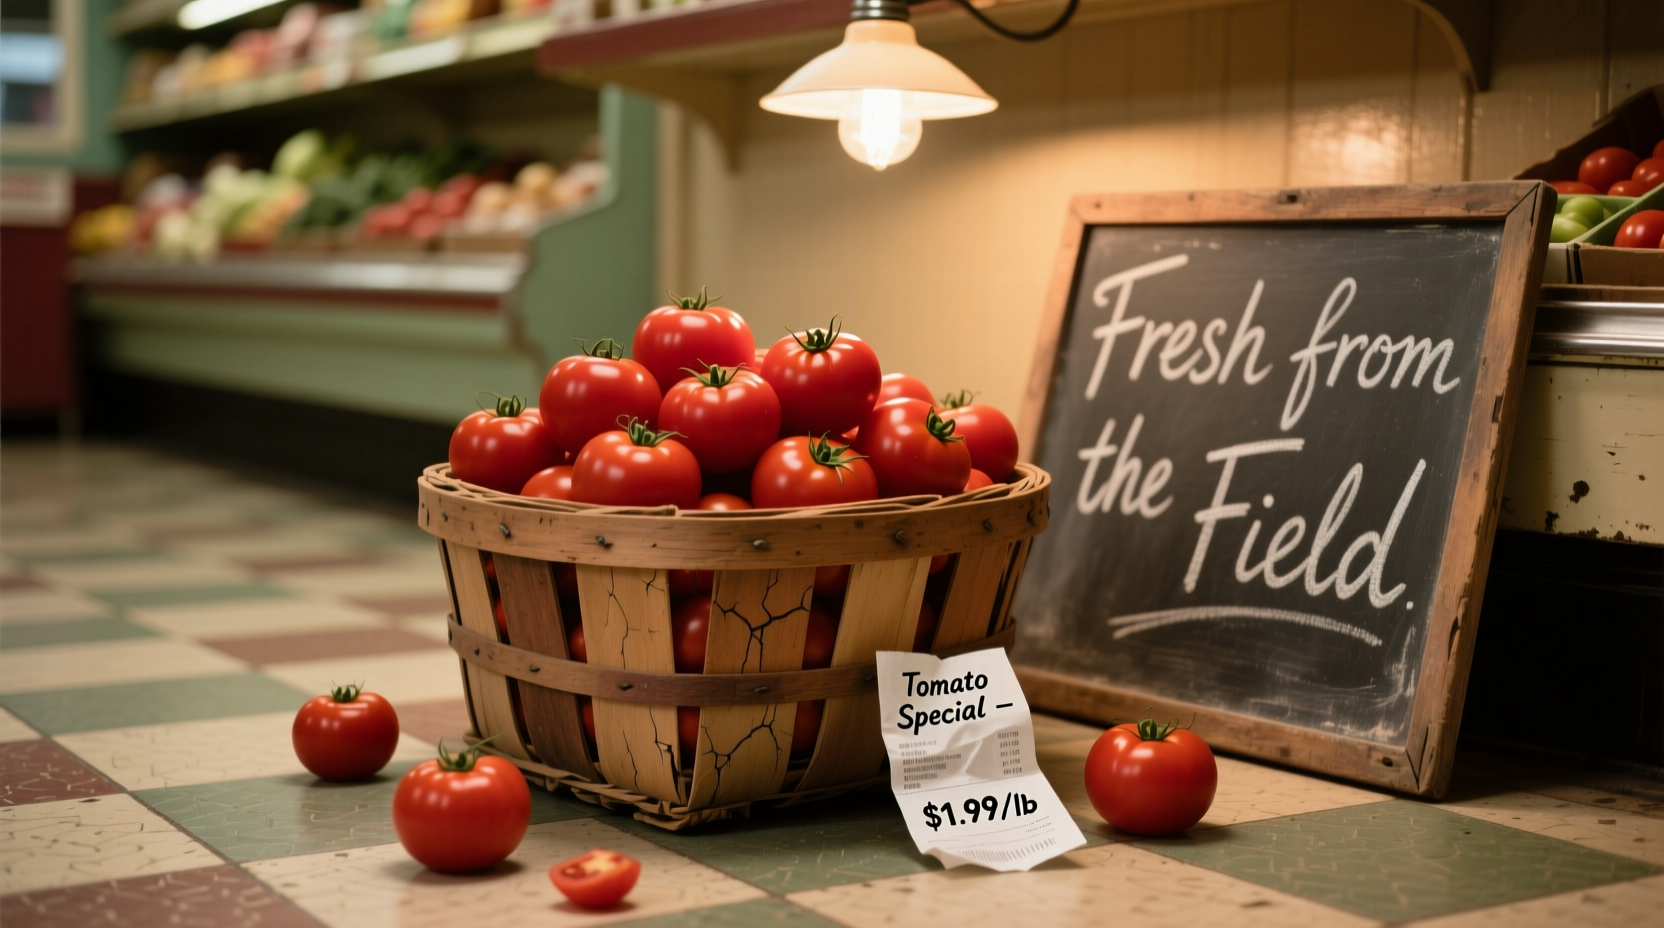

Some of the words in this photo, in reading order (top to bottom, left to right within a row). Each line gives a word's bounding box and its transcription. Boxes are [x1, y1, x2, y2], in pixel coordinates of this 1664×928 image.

[1085, 253, 1273, 400] Fresh
[1280, 276, 1461, 431] from
[1077, 413, 1174, 519] the
[1183, 437, 1427, 609] Field.
[902, 671, 988, 697] Tomato
[897, 695, 986, 736] Special
[922, 792, 1038, 832] $1.99/lb
